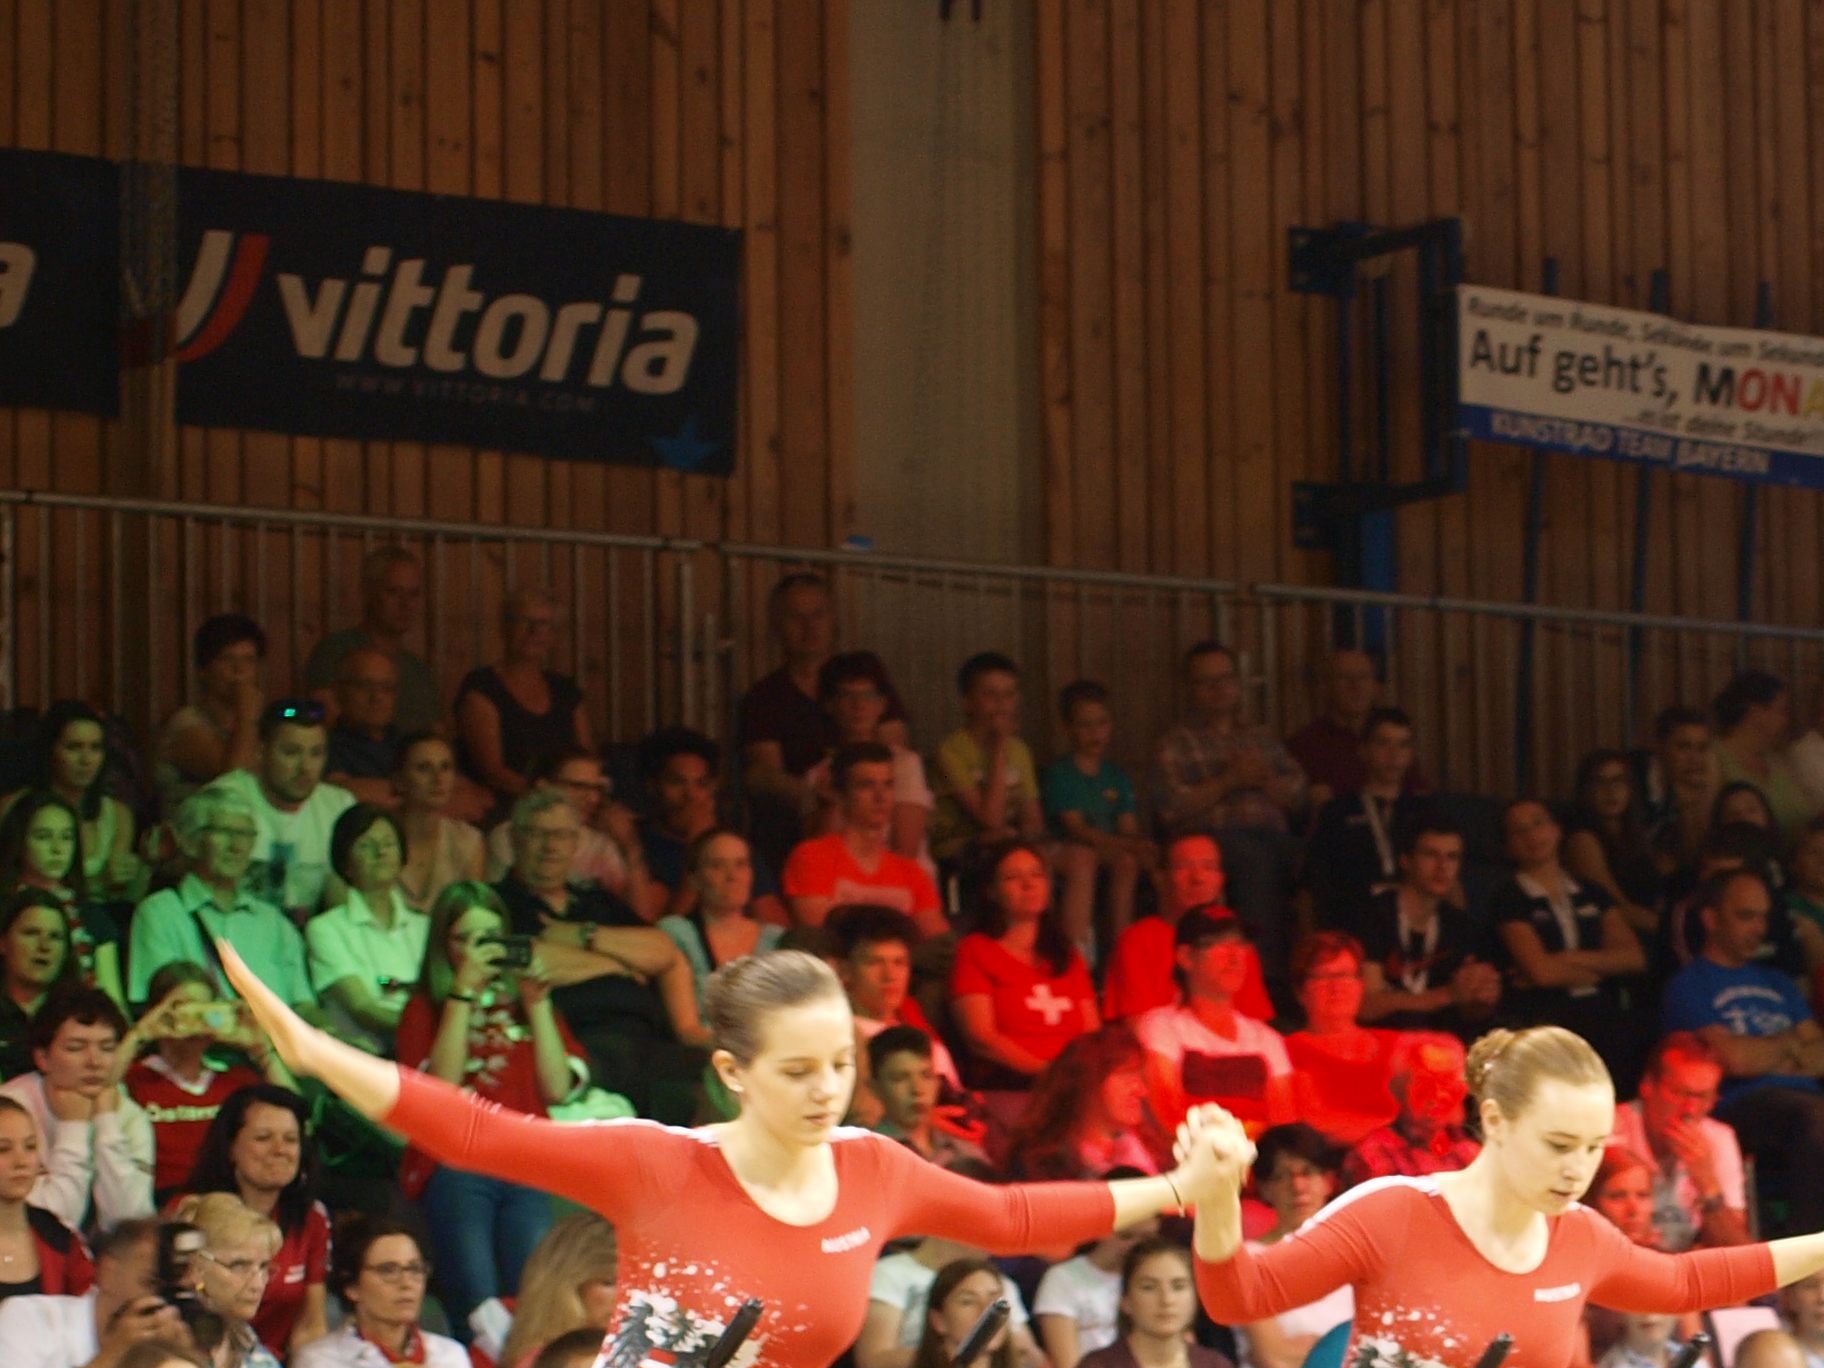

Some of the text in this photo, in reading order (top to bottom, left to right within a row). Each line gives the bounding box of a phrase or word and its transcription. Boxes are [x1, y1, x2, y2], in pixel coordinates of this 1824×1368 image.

[276, 245, 699, 395] vittoria
[1470, 329, 1542, 378] Auf
[1553, 346, 1678, 408] geht's,
